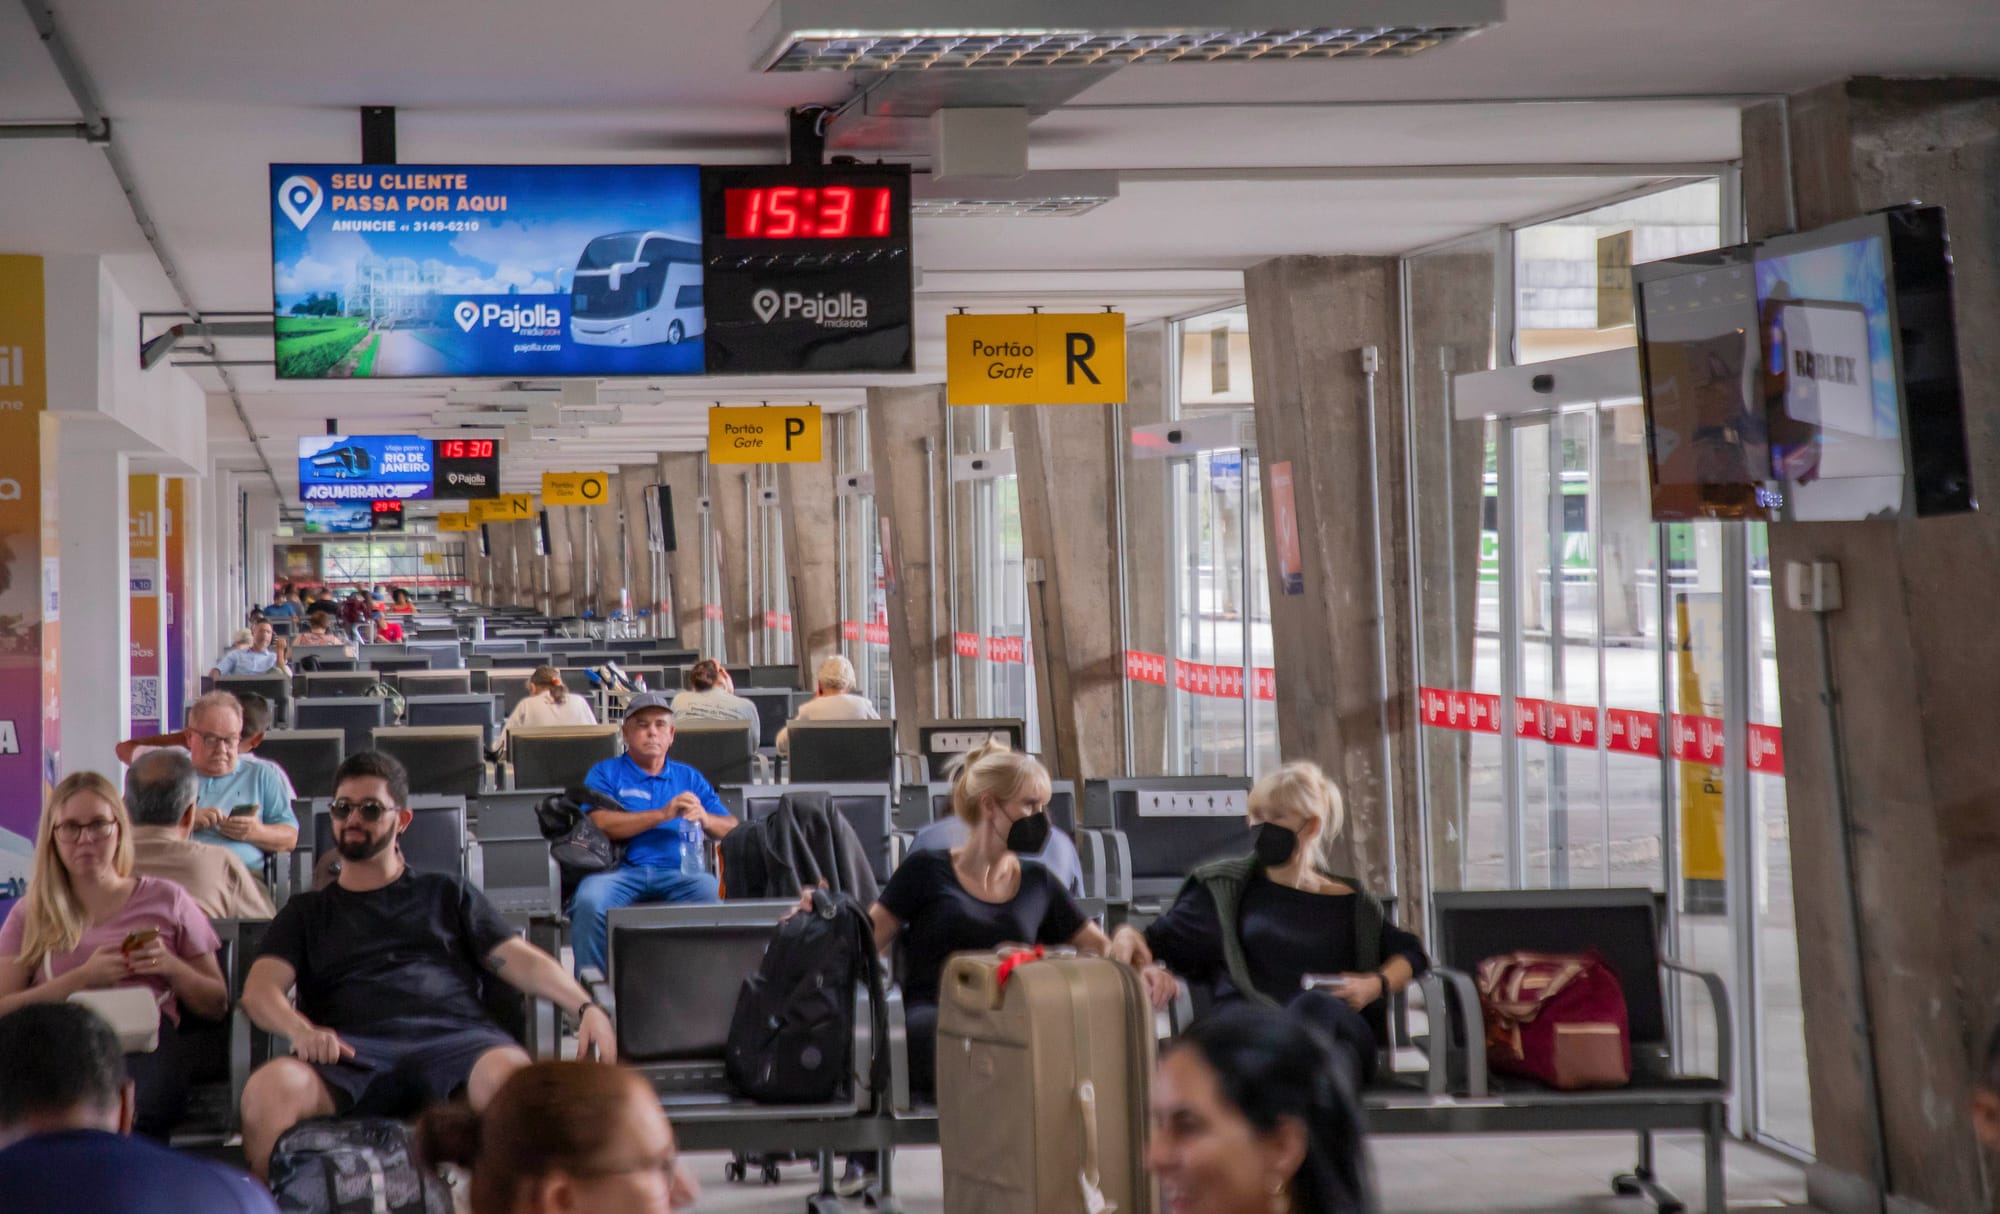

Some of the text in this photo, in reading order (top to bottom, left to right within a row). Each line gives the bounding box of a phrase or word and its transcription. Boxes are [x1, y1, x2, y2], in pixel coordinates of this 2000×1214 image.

[331, 173, 468, 190] SEU CLIENTE
[331, 195, 508, 213] PASSA POR AQUI
[743, 188, 892, 237] 15:31
[331, 220, 396, 232] ANUNCIE
[413, 221, 480, 232] 3149-6210
[783, 292, 868, 324] Pajolla
[482, 303, 561, 333] Pajolla
[513, 343, 561, 353] pajolla.com
[973, 339, 1034, 358] Portão
[1065, 332, 1102, 385] R
[987, 362, 1034, 380] Gate
[724, 422, 764, 435] Portão
[785, 417, 805, 450] P
[733, 438, 764, 449] Gate
[384, 453, 424, 463] RIO DE
[380, 463, 431, 474] JANEIRO
[513, 498, 527, 514] N
